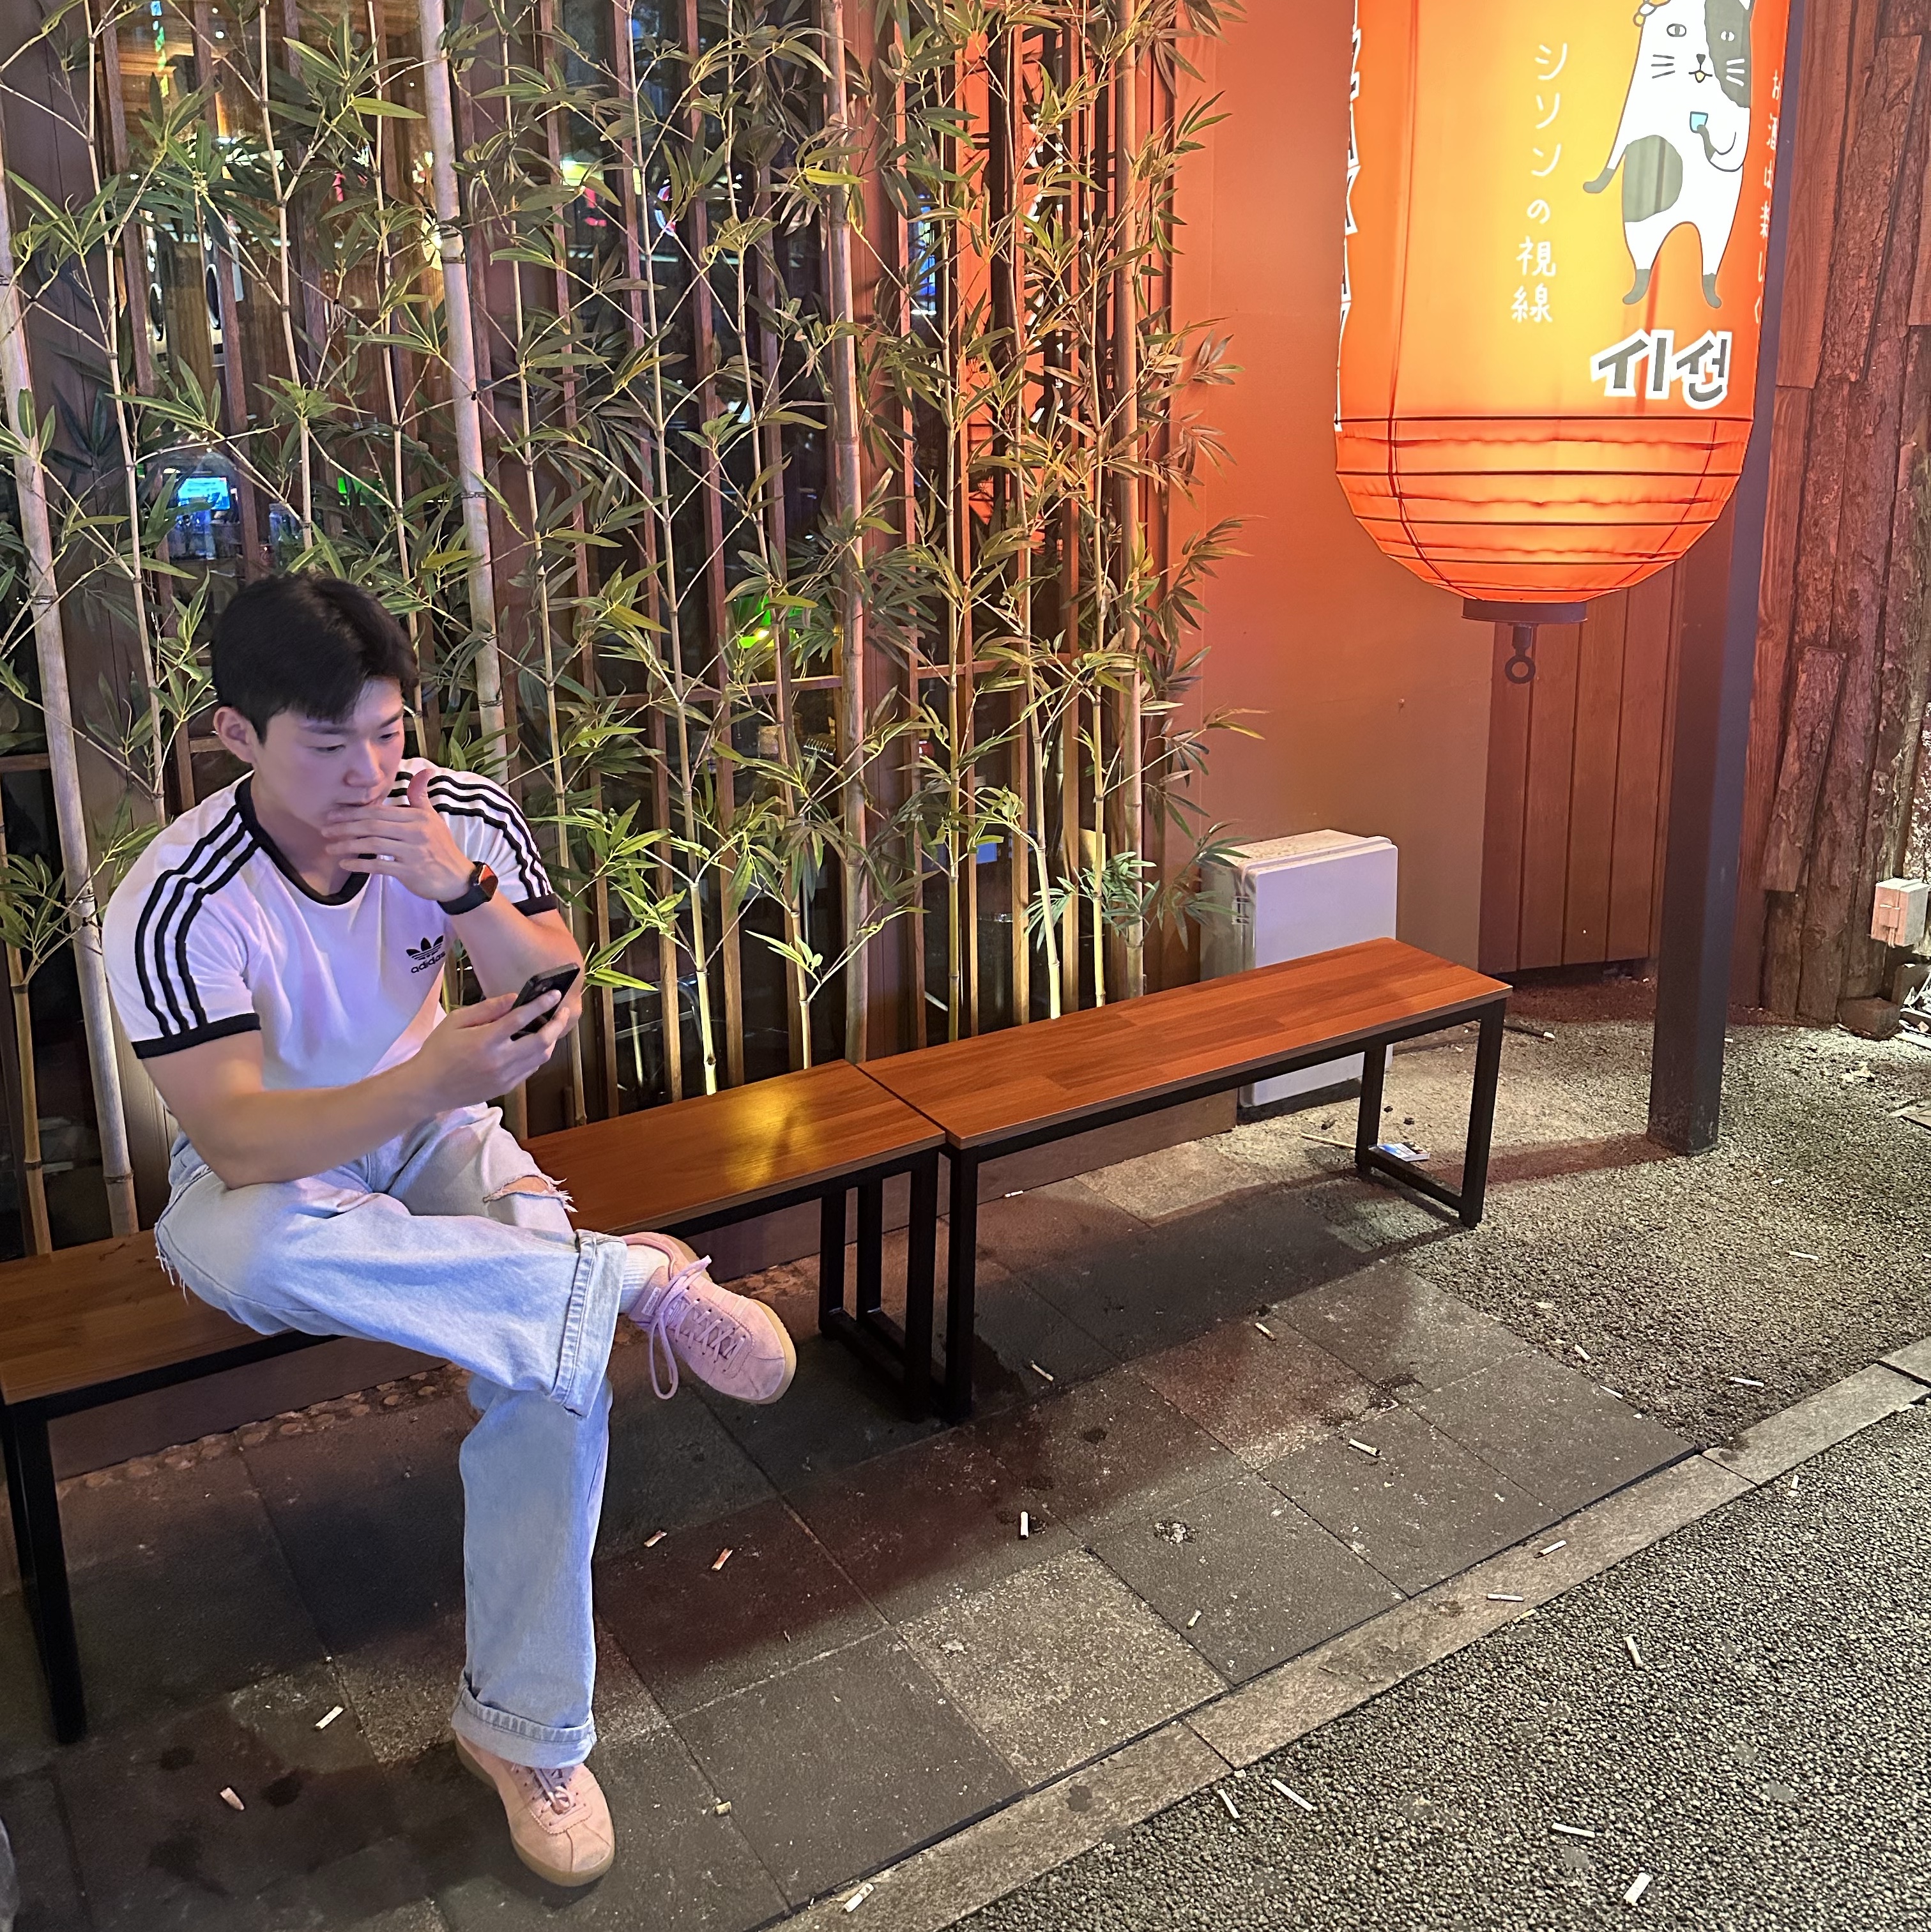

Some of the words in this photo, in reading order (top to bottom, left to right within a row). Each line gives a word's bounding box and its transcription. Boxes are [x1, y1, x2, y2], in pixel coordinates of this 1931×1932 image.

[1511, 42, 1568, 323] シソンの視線
[1593, 331, 1730, 407] 시선
[411, 951, 446, 973] adidas
